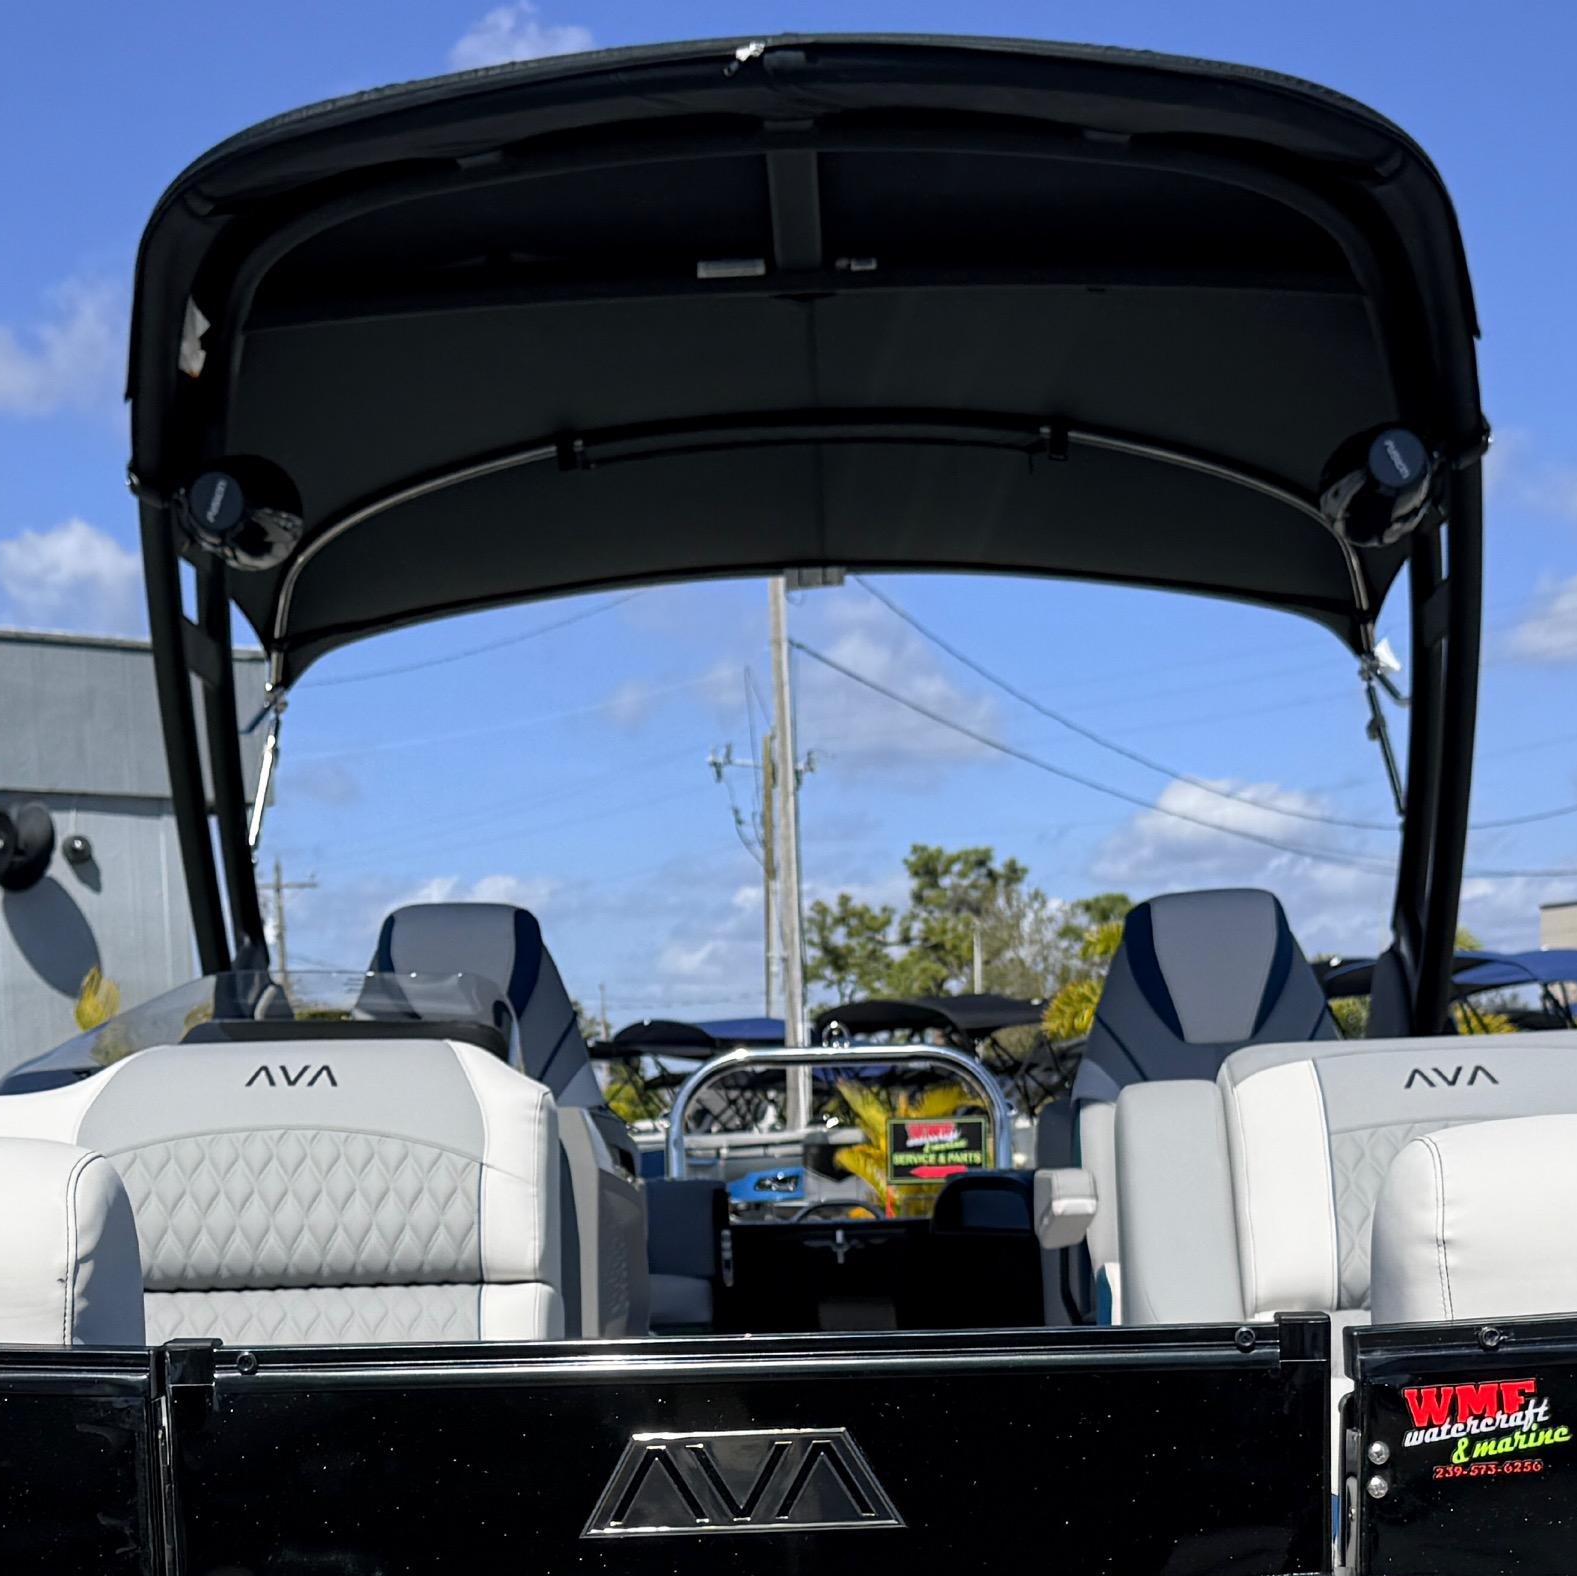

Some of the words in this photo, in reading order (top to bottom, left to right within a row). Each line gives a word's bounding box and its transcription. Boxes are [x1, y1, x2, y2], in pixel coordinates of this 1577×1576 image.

[244, 1064, 338, 1088] AVA
[1403, 1064, 1499, 1089] AVA
[892, 1152, 936, 1166] SERVICE
[938, 1152, 946, 1166] &
[948, 1151, 982, 1165] PARTS
[1403, 1378, 1537, 1428] WMF
[1403, 1397, 1551, 1448] watercraft
[1451, 1437, 1470, 1464] &
[1472, 1424, 1573, 1459] marine
[608, 1438, 878, 1528] AVA
